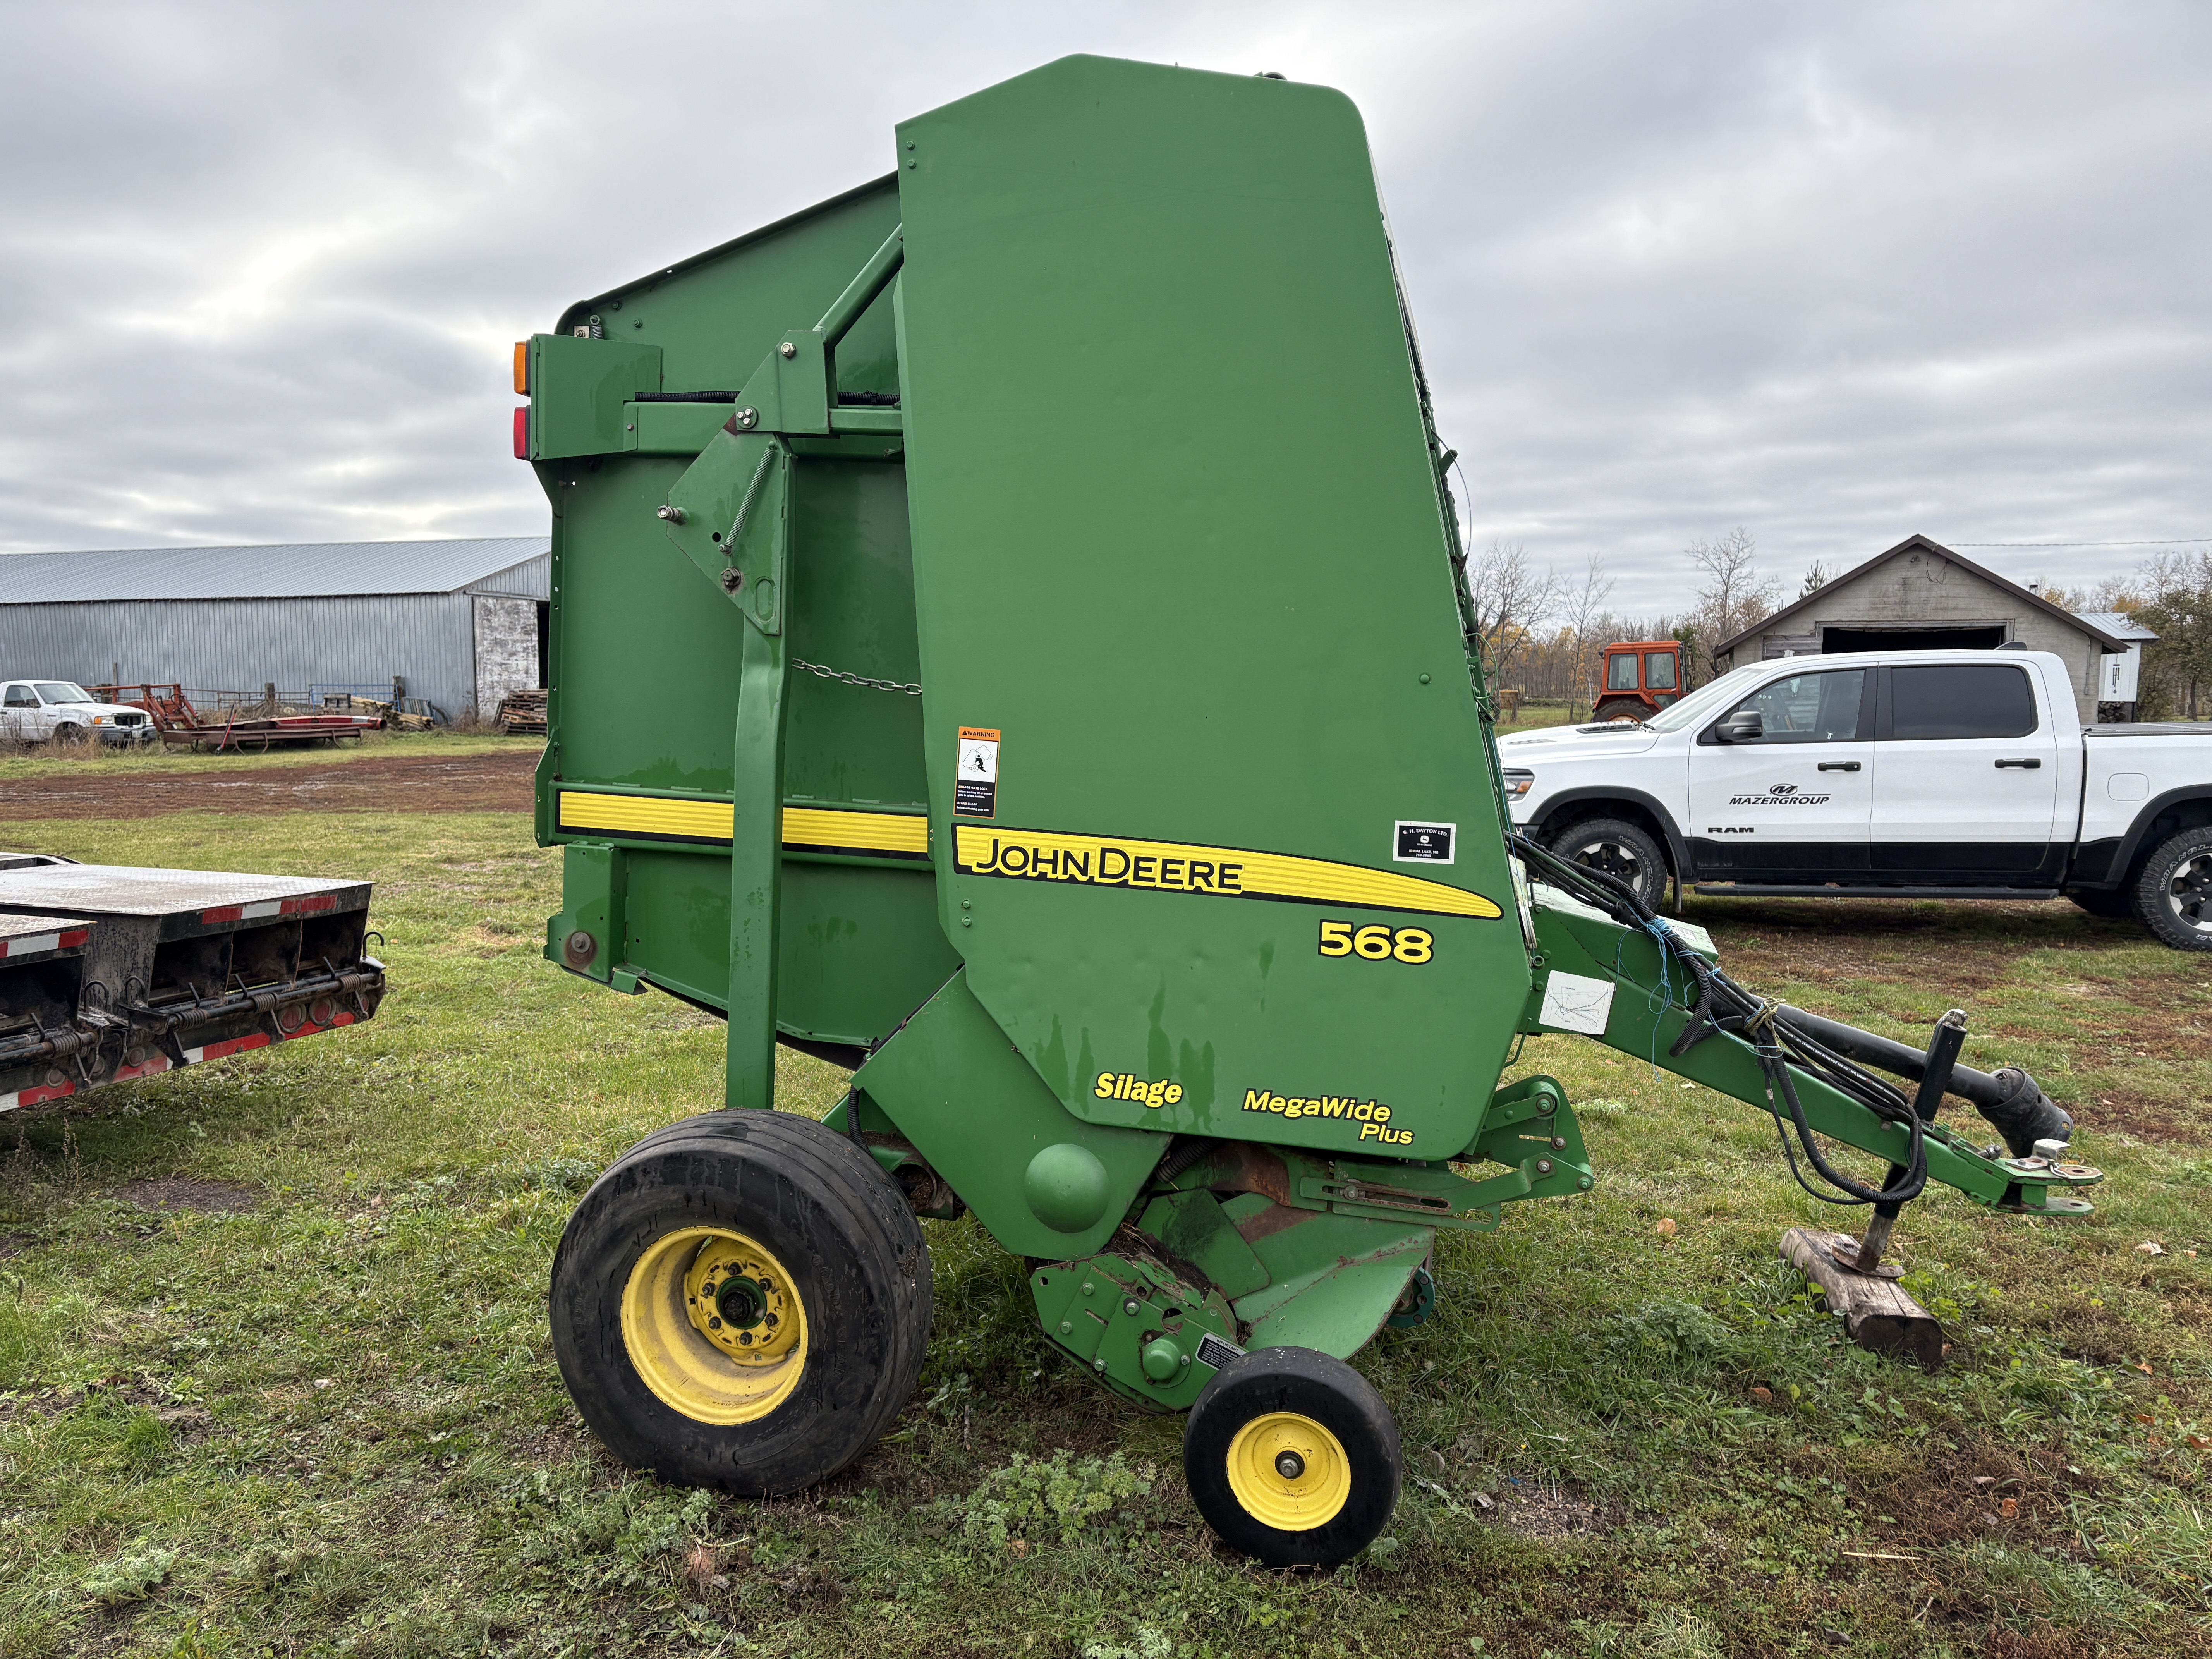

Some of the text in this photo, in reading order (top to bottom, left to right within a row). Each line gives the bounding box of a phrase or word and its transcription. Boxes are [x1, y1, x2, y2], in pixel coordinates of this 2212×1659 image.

[1729, 797, 1831, 805] MAZERGROUP
[976, 838, 1243, 890] JOHN DEERE
[1620, 835, 1653, 902] WRANGLER
[2159, 844, 2212, 891] WRANGL
[1319, 920, 1434, 965] 568
[1094, 1072, 1183, 1108] Silage
[1242, 1088, 1392, 1122] MegaWide
[1358, 1122, 1415, 1146] Plus
[1217, 1339, 1239, 1352] IMPORTANT
